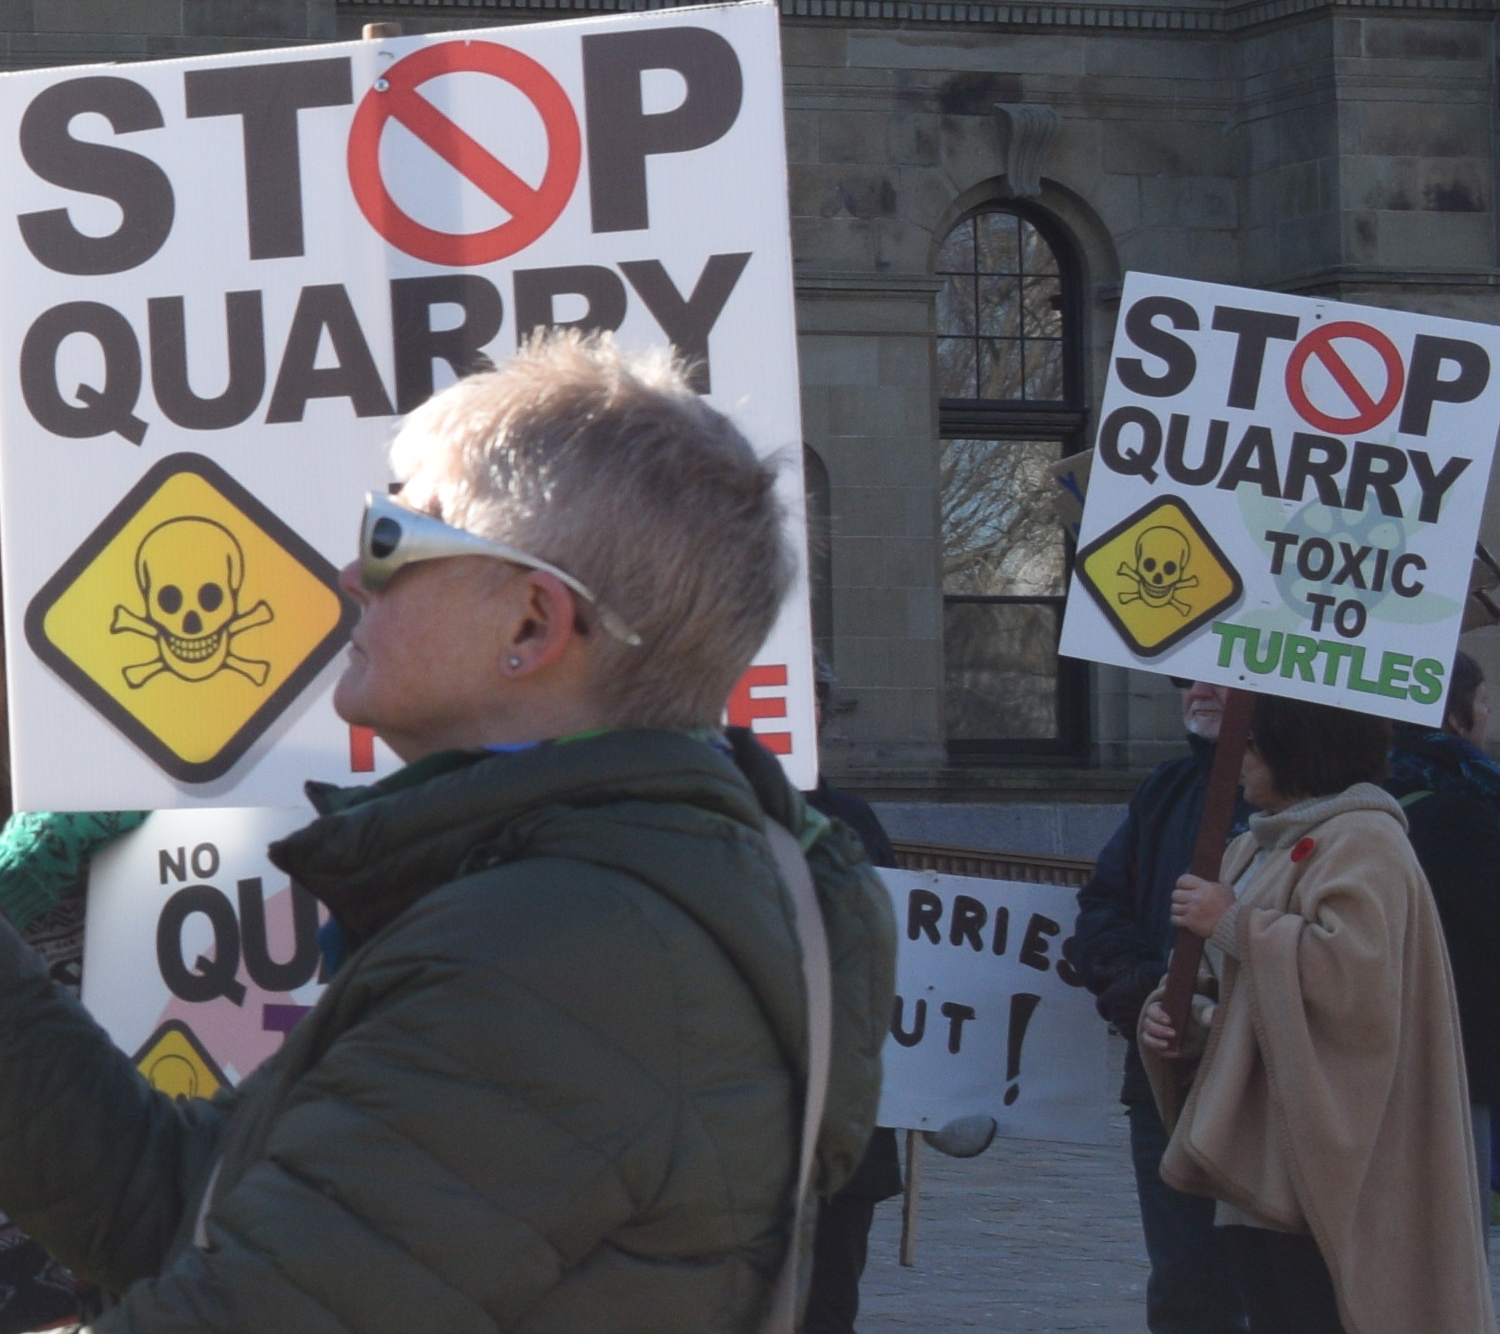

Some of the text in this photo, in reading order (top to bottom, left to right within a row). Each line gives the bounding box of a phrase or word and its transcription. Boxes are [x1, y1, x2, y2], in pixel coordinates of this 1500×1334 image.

[1100, 405, 1473, 525] QUARRY
[1264, 529, 1428, 598] TOXIC
[1306, 591, 1367, 639] TO
[1212, 620, 1445, 706] TURTLES
[159, 842, 220, 885] NO
